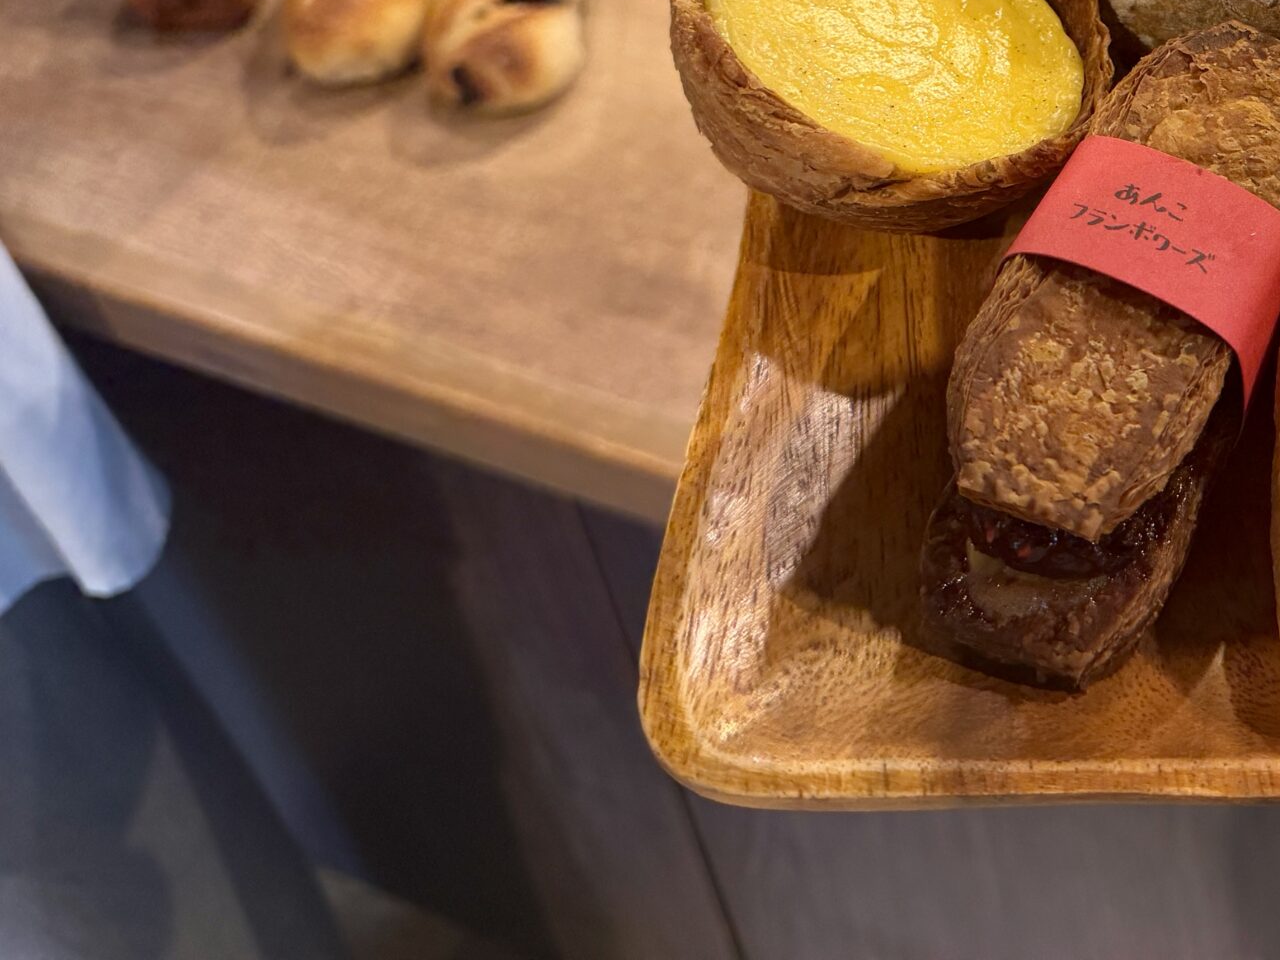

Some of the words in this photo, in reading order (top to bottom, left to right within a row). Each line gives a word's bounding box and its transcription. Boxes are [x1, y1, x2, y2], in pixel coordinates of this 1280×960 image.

[1114, 183, 1188, 222] あんこ
[1069, 202, 1216, 274] フランボワーズ
